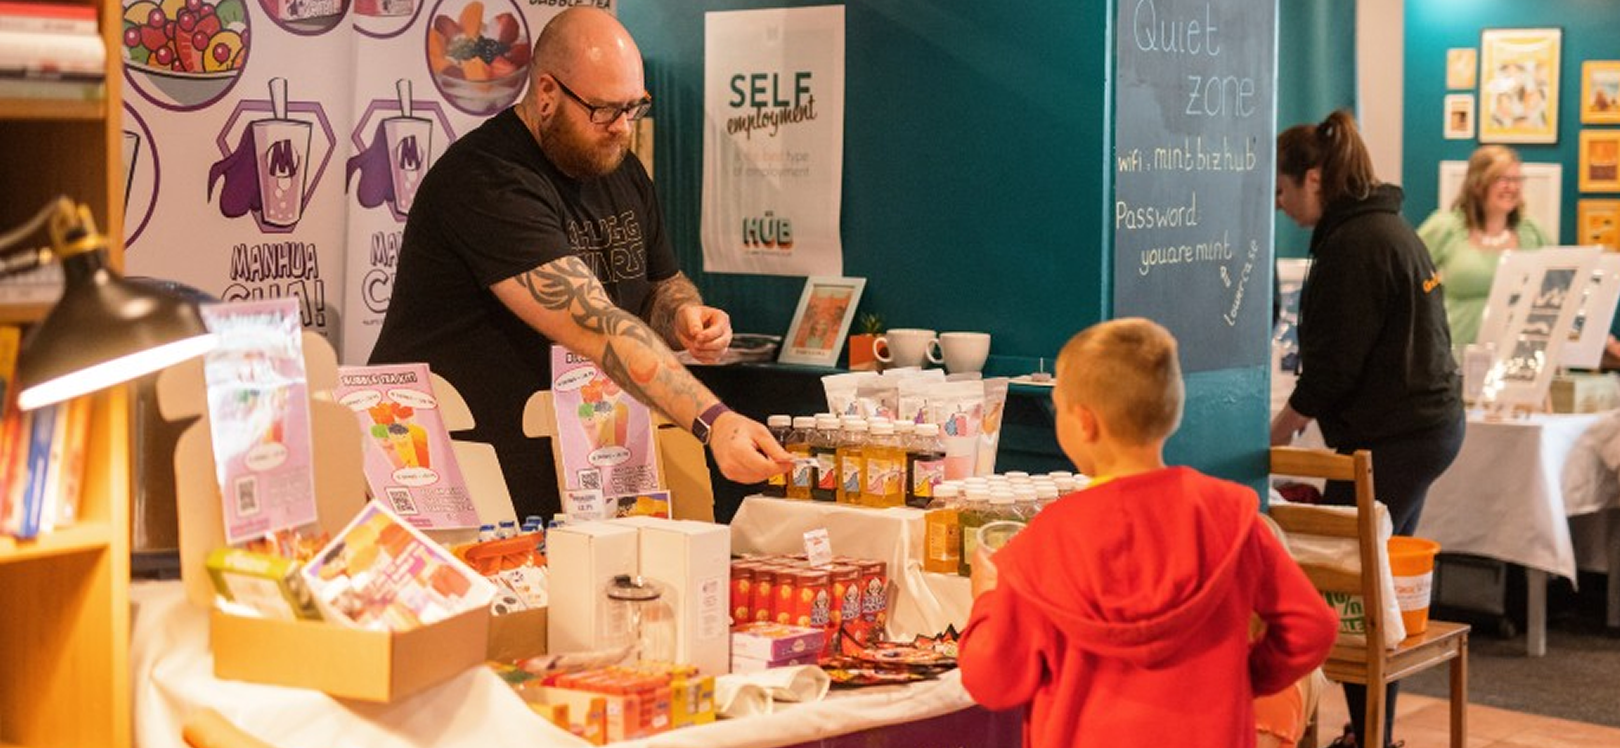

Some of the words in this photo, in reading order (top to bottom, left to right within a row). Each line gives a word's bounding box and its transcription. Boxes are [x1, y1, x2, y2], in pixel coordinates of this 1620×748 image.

[1134, 0, 1220, 56] Quiet
[729, 72, 812, 108] SELF
[1186, 75, 1256, 117] zone
[727, 94, 818, 141] employment
[1116, 190, 1198, 230] Password
[229, 242, 320, 282] MANHUA
